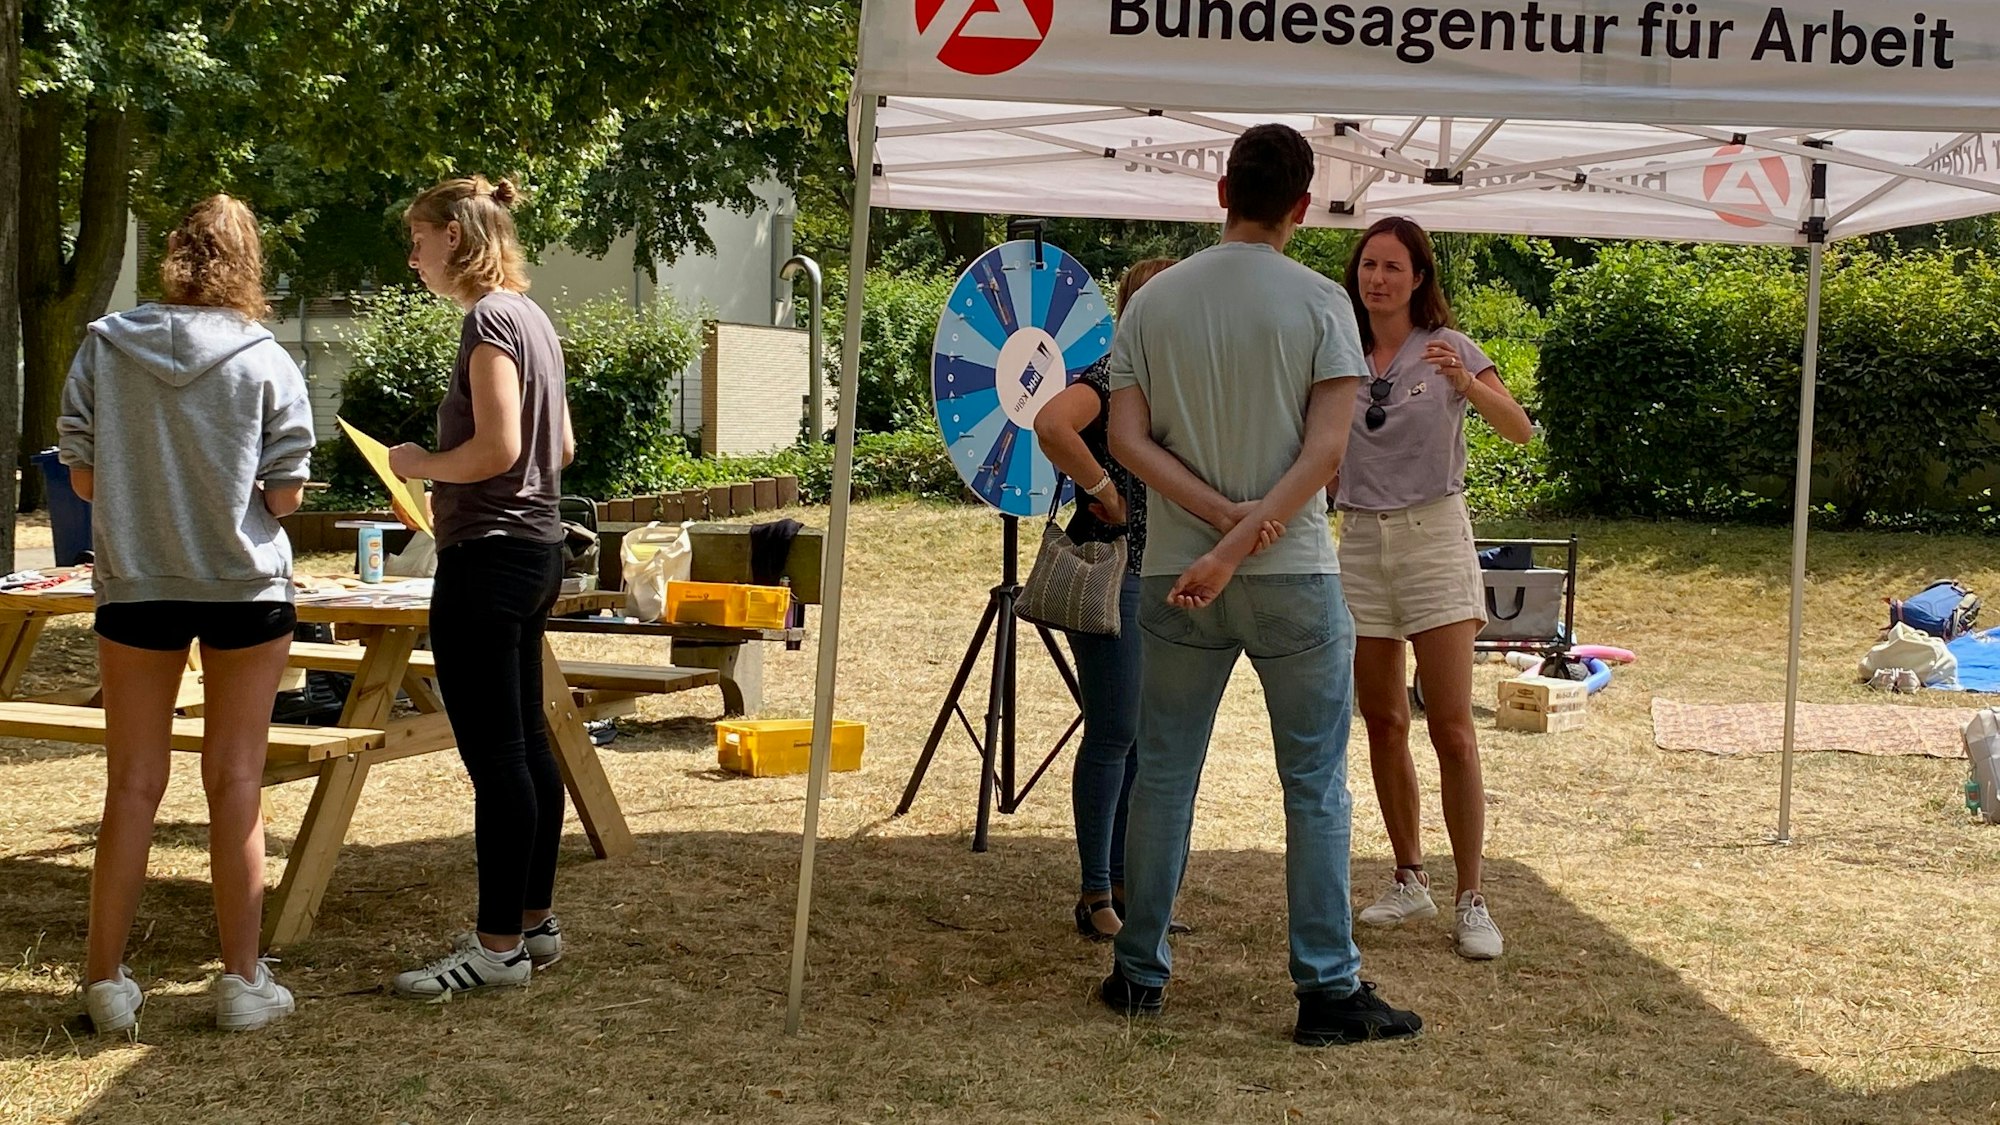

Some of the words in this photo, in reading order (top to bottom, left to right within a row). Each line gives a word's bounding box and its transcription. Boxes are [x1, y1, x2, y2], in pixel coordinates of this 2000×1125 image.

[1110, 0, 1618, 63] Bundesagentur
[1639, 1, 1734, 60] für
[1751, 7, 1955, 69] Arbeit
[1026, 371, 1041, 393] IHK
[1014, 392, 1029, 413] Köln
